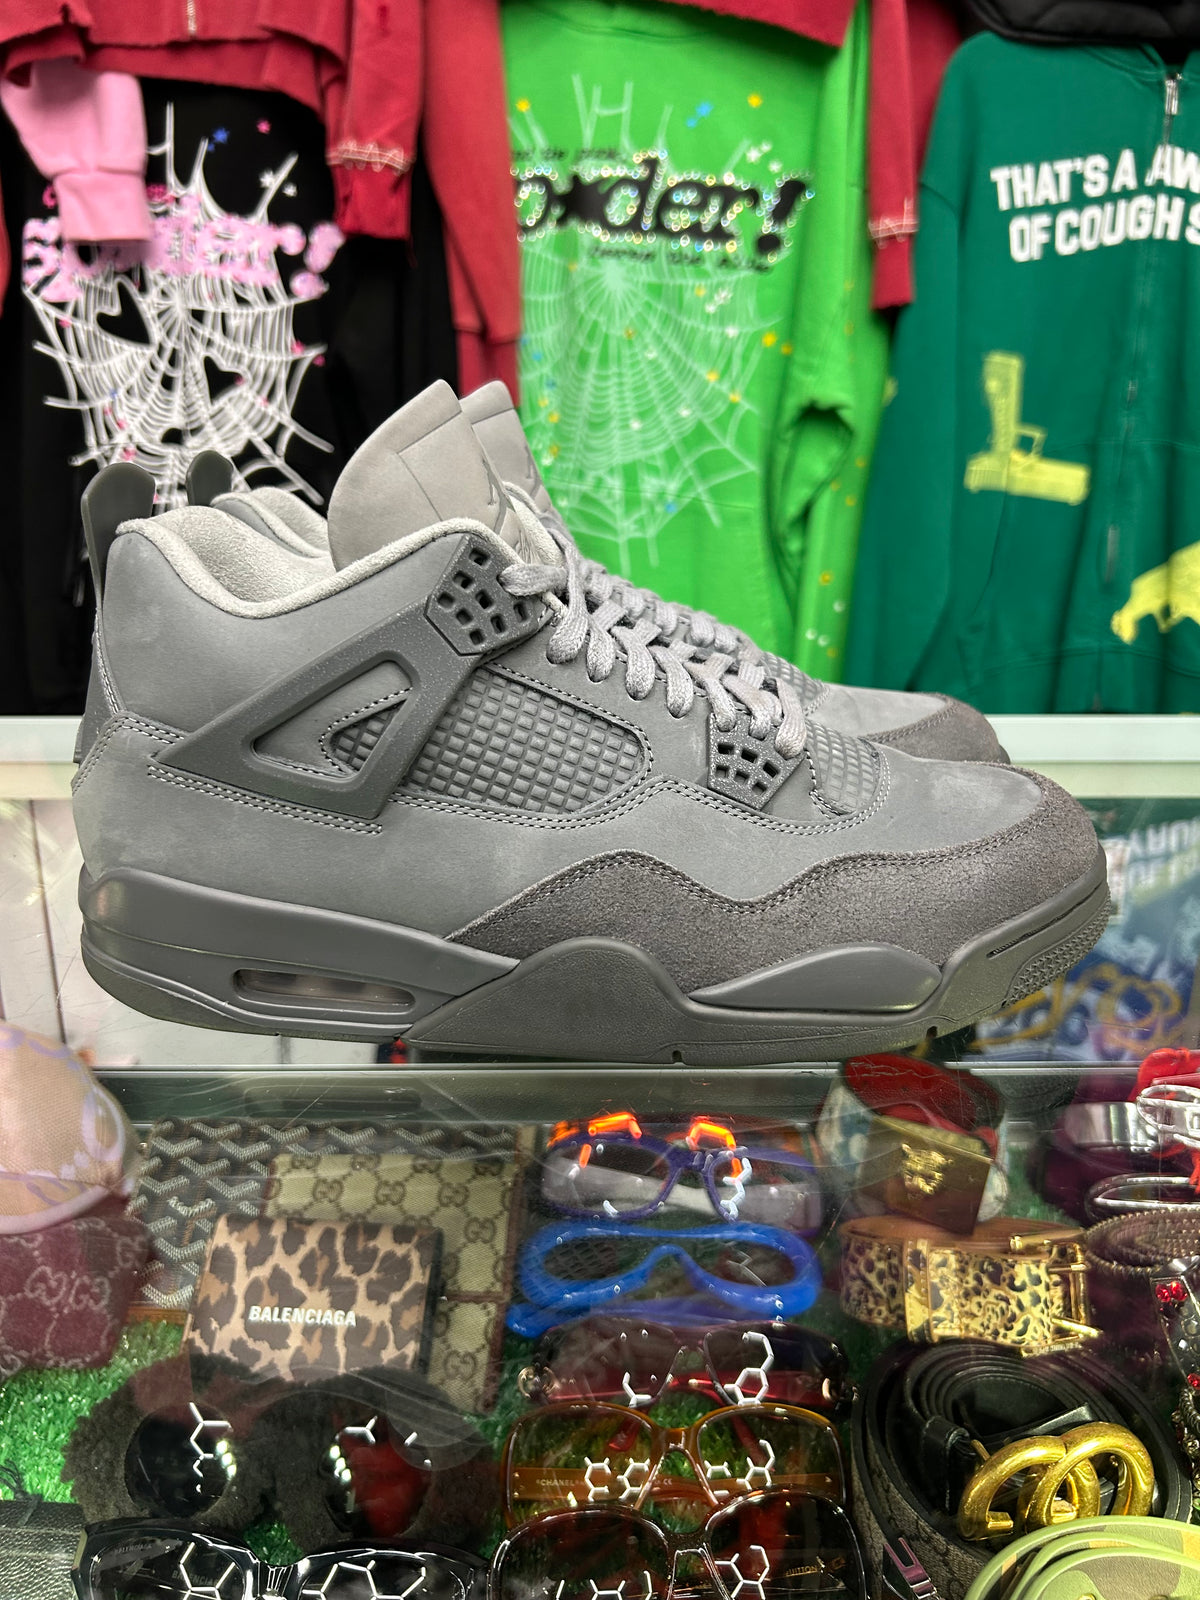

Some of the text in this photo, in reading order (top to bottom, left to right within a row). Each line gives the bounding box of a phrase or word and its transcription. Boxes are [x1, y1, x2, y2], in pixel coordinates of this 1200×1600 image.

[990, 153, 1109, 211] THAT'S
[1111, 148, 1138, 193] A
[1009, 213, 1052, 262] OF
[1054, 194, 1185, 256] COUGH
[248, 1304, 357, 1328] BALENCIAGA
